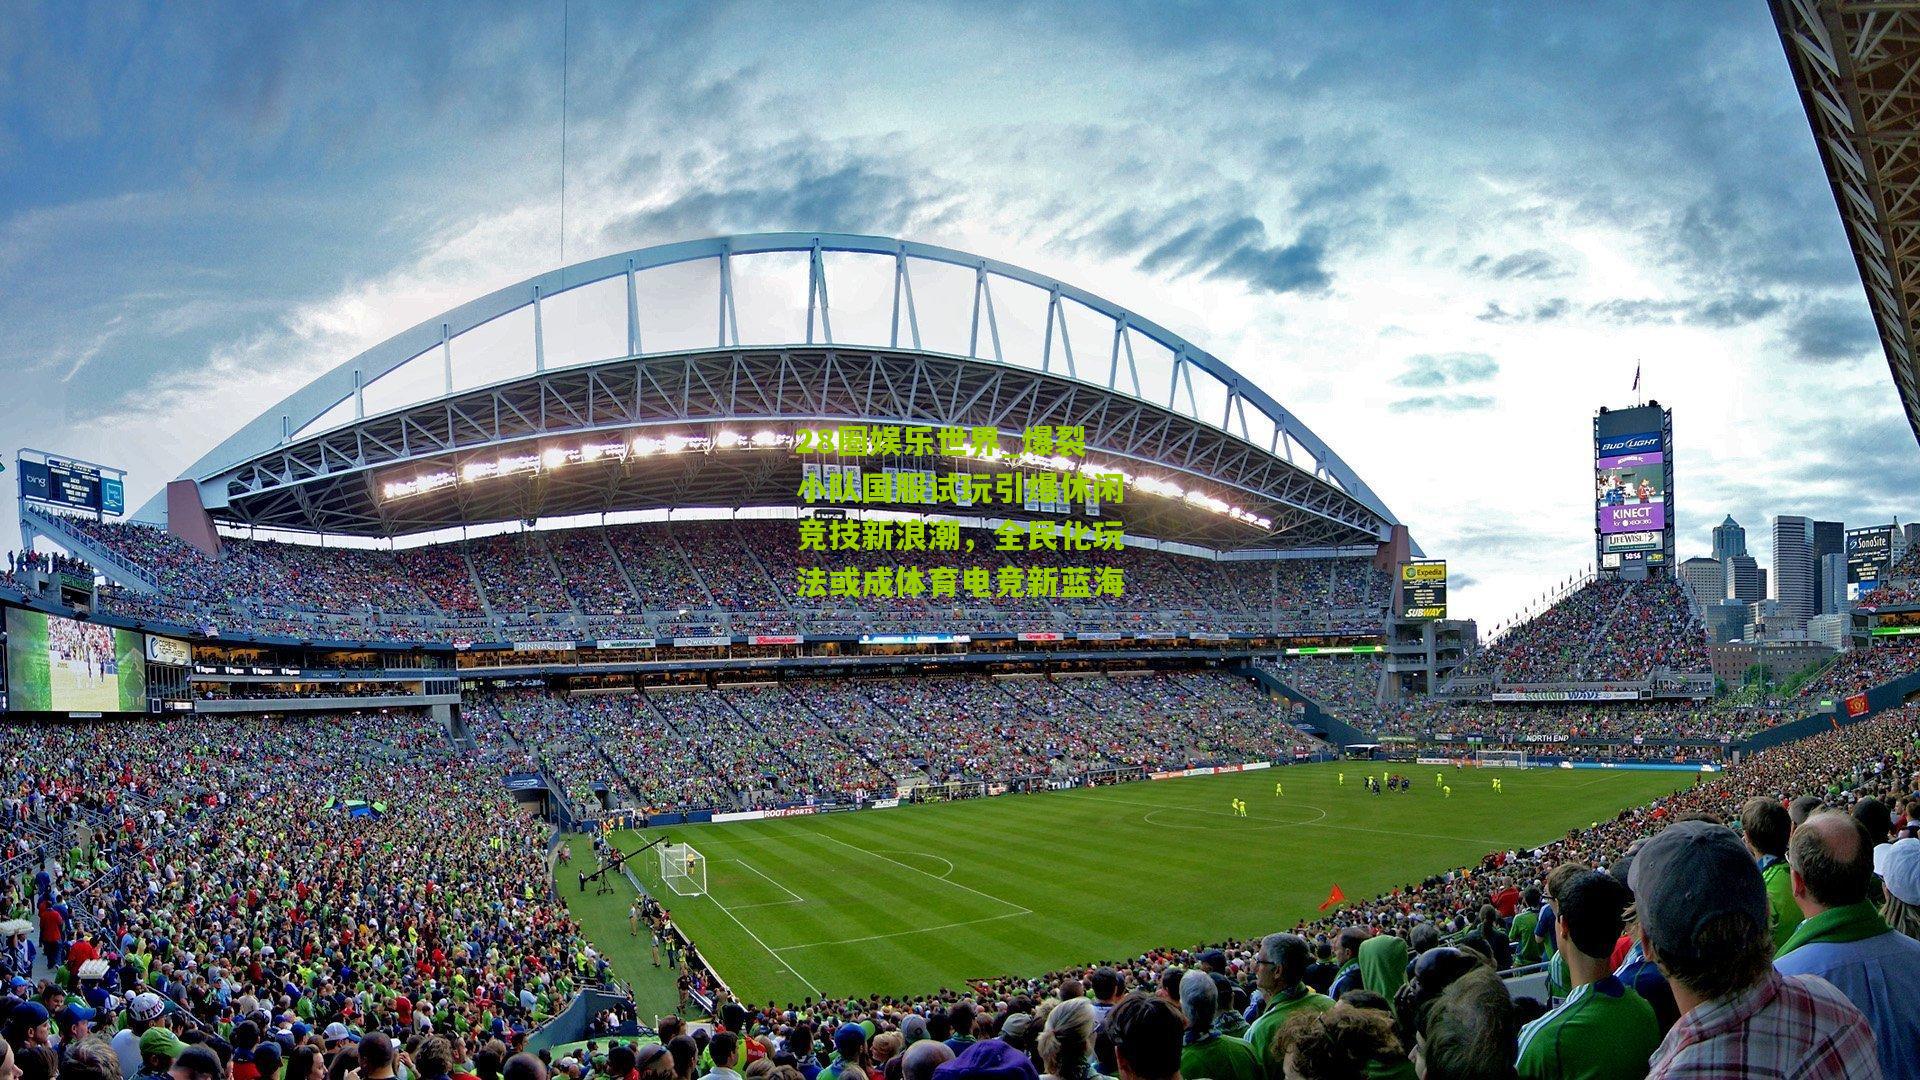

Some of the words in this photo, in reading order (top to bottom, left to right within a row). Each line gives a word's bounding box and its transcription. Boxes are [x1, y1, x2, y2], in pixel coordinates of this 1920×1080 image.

[1628, 439, 1658, 447] LIGHT
[26, 474, 46, 487] bing
[1613, 507, 1652, 519] KINECT
[1858, 536, 1886, 549] SonoSite
[1417, 568, 1442, 577] Expedia
[1405, 608, 1445, 618] SUBWAY
[685, 637, 711, 646] Qwest
[1553, 734, 1569, 742] END
[765, 809, 785, 818] ROOT
